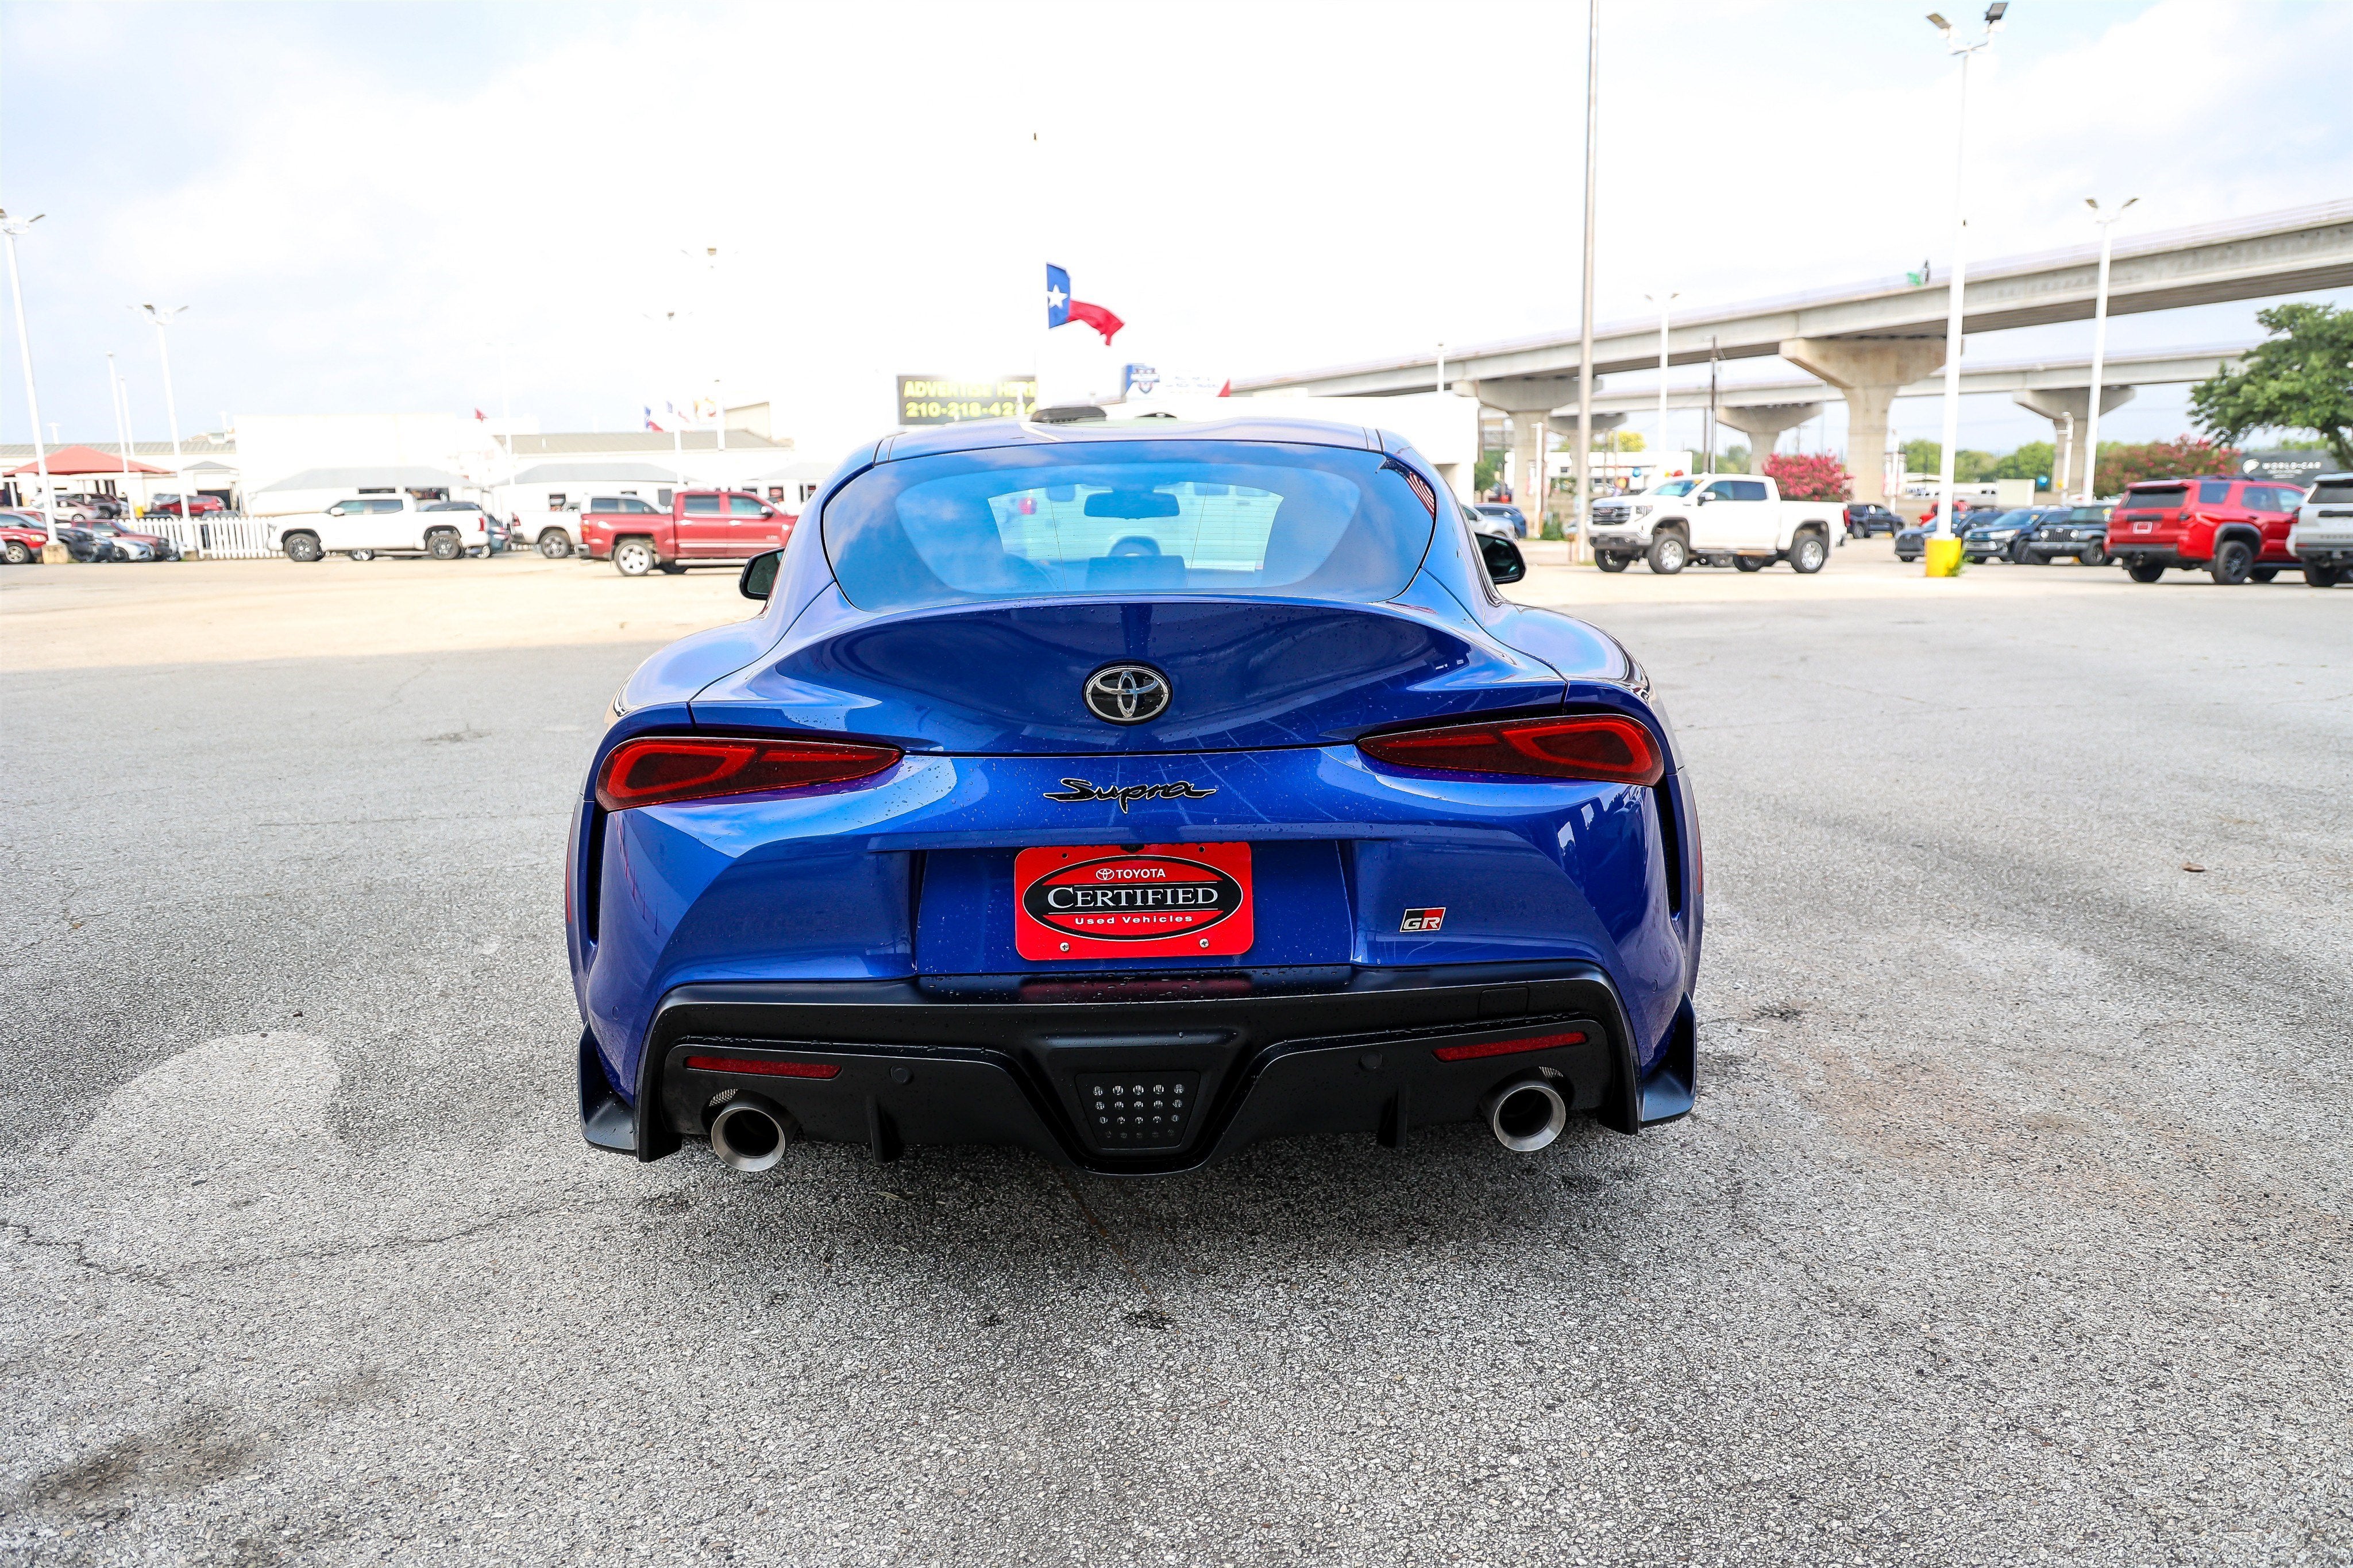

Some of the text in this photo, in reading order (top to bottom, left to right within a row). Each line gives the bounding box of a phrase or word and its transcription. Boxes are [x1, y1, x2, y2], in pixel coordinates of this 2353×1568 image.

[1043, 778, 1217, 814] Supra
[1116, 868, 1166, 879] TOYOTA
[1075, 915, 1193, 925] Used Vehicles
[1403, 917, 1441, 930] GR
